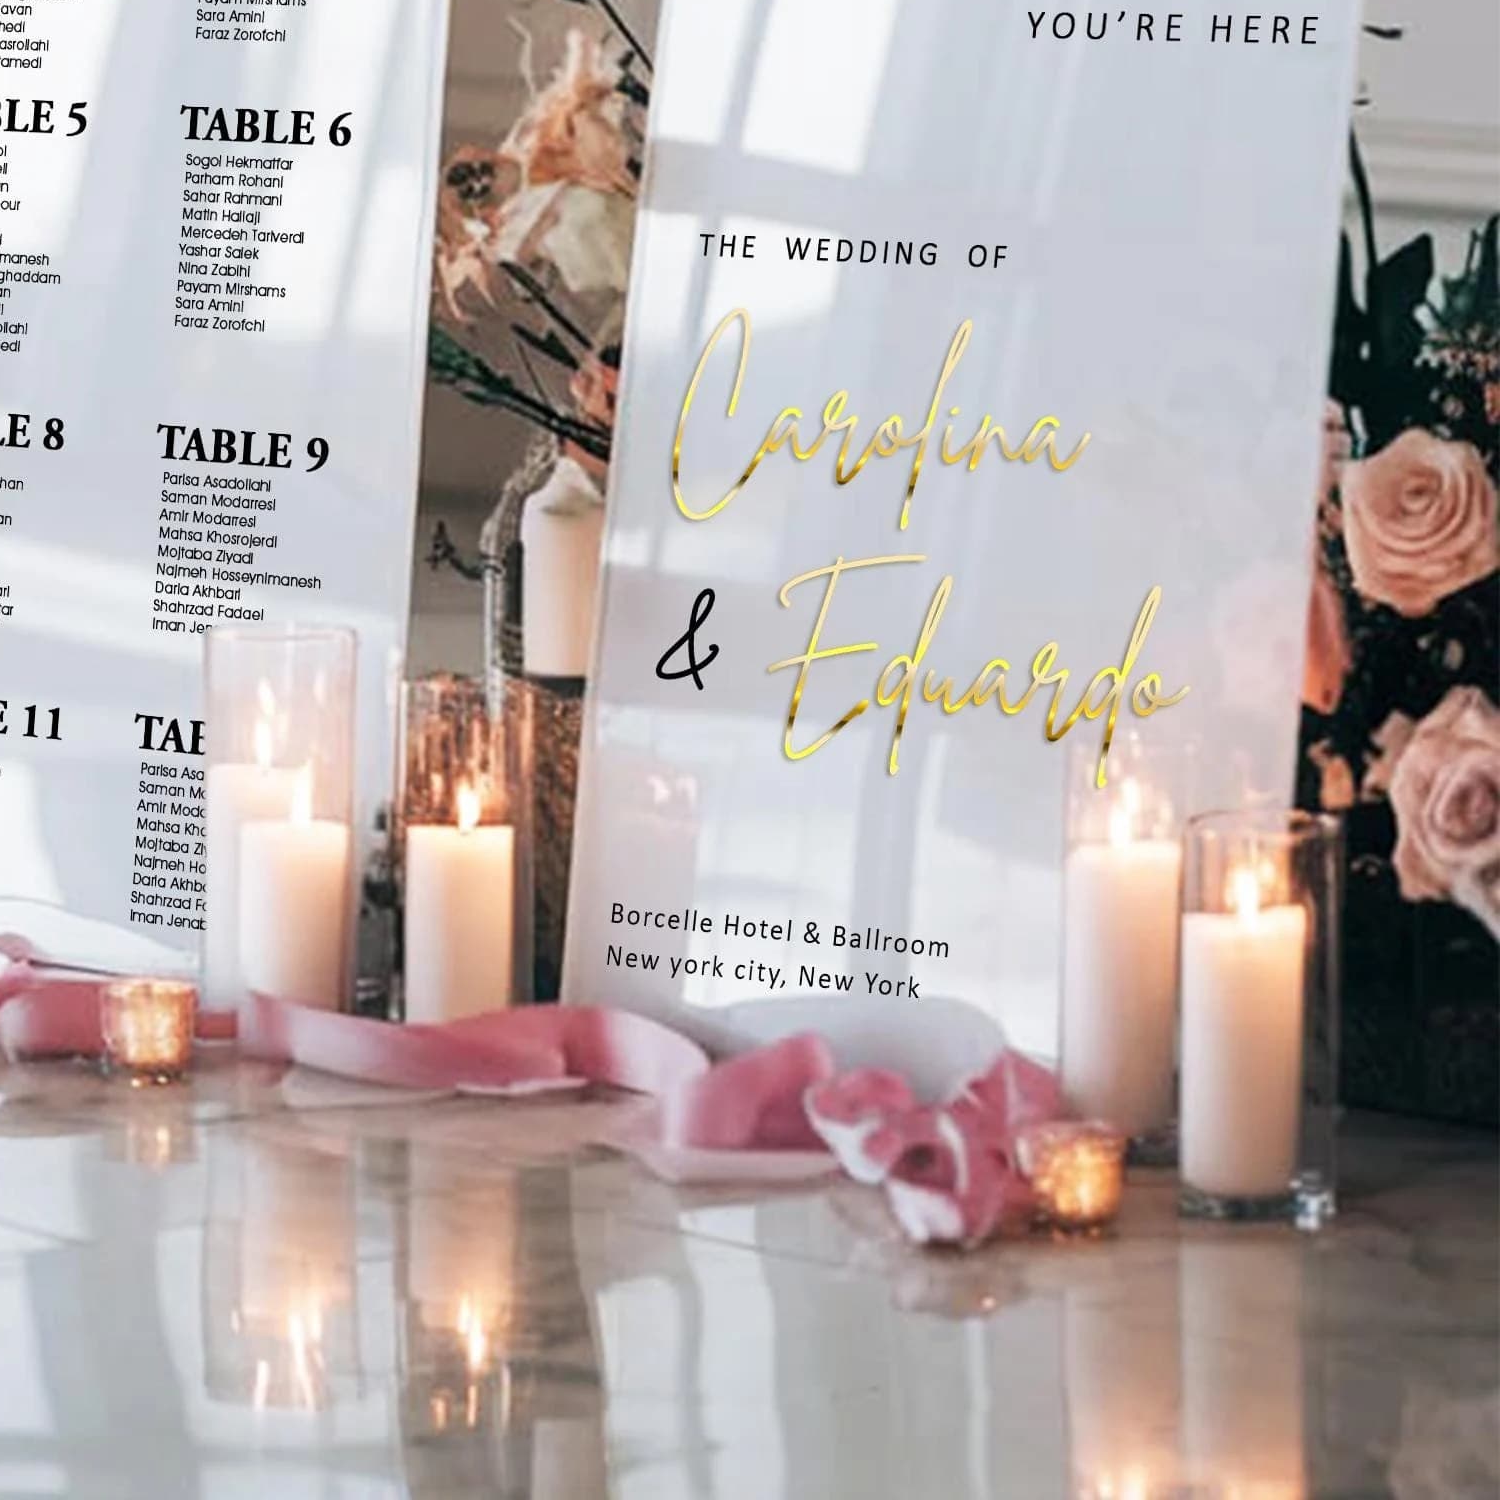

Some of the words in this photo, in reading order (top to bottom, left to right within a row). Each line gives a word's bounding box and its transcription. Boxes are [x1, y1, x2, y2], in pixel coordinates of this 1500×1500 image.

[195, 26, 230, 41] Faraz
[1210, 14, 1319, 45] HERE
[65, 101, 88, 137] 5
[179, 104, 316, 146] TABLE
[328, 111, 353, 147] 6
[185, 153, 222, 170] Sogol
[182, 189, 221, 204] Sahar
[178, 243, 222, 258] Yashar
[224, 245, 260, 260] Salek
[699, 233, 757, 259] THE
[785, 236, 938, 266] WEDDING
[968, 244, 1008, 269] OF
[42, 417, 65, 451] 8
[670, 308, 1092, 530] Carolina
[156, 423, 293, 469] TABLE
[305, 437, 330, 473] 9
[160, 489, 208, 506] Saman
[156, 562, 207, 580] Najmeh
[152, 598, 214, 617] Shahrzad
[655, 587, 720, 691] &
[765, 553, 1192, 788] Eduardo
[22, 704, 63, 741] 11
[138, 780, 185, 798] Saman
[136, 816, 181, 835] Mahsa
[130, 890, 192, 911] Shahrzad
[610, 902, 713, 933] Borcelle
[724, 914, 793, 942] Hotel
[803, 921, 821, 945] &
[832, 925, 949, 958] Ballroom
[606, 944, 660, 971] New
[669, 954, 724, 979] york
[734, 959, 786, 990] city,
[798, 965, 855, 992] New
[864, 971, 920, 999] York
